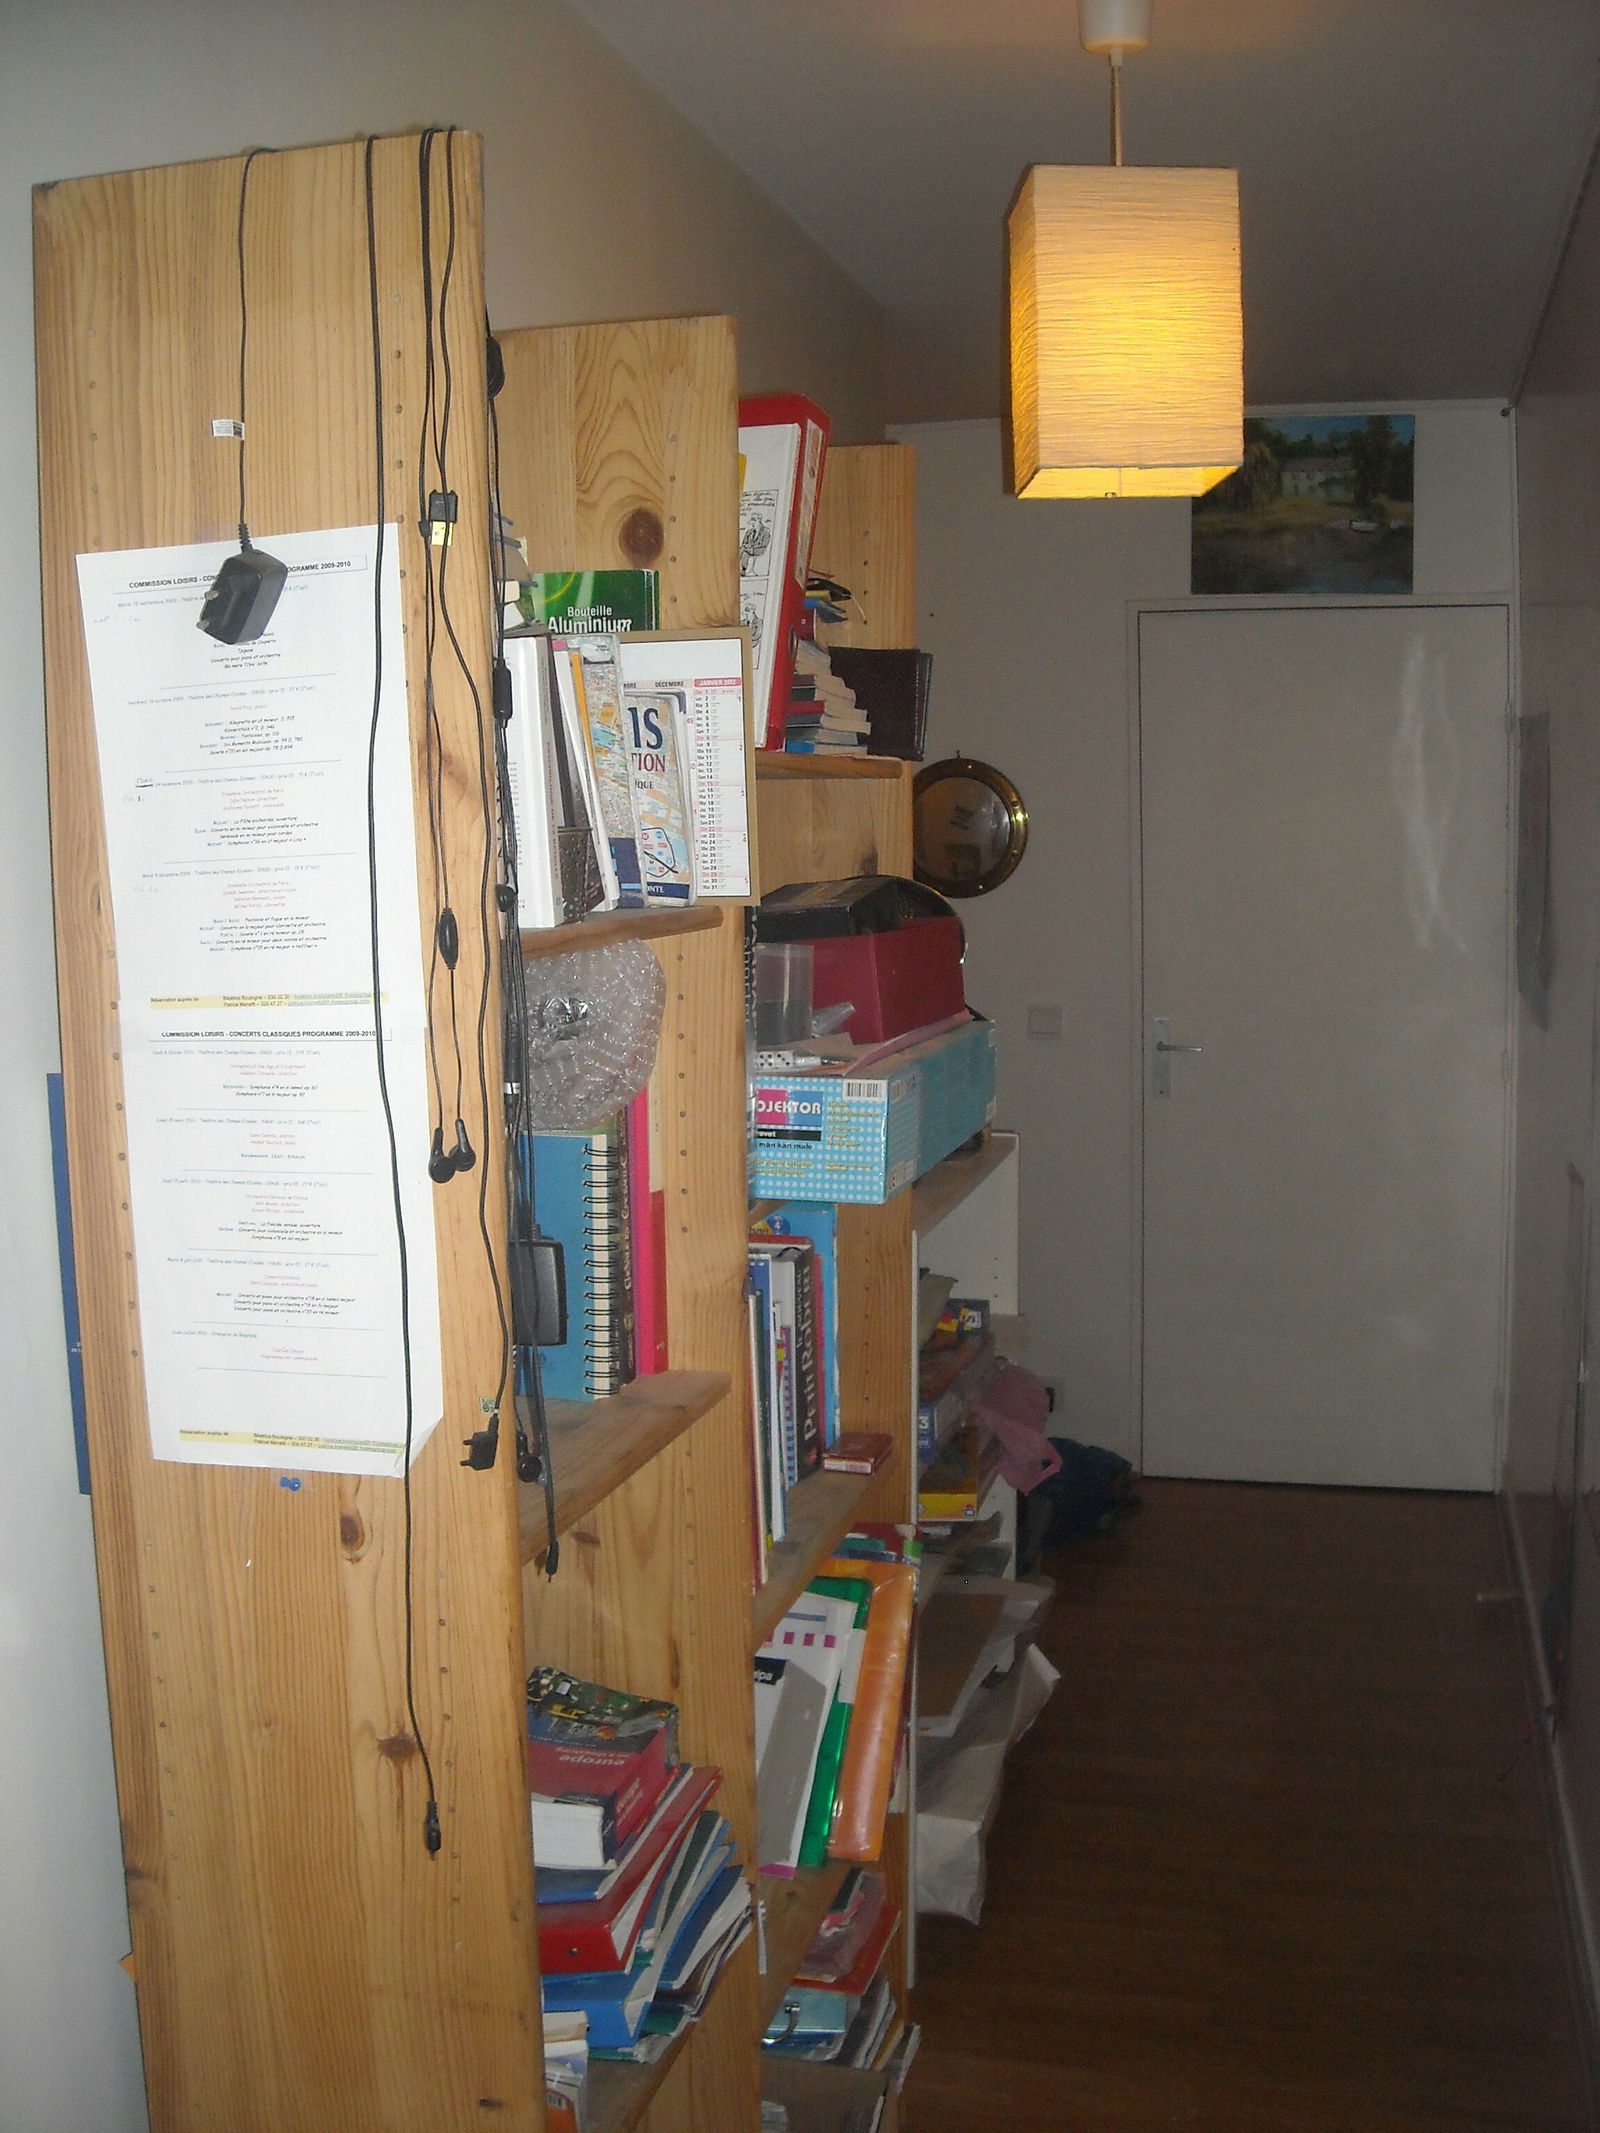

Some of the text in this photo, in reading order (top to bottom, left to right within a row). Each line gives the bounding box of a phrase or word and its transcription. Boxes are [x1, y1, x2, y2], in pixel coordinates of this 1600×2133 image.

[286, 560, 352, 573] OGRAMME 2009-2010
[128, 578, 172, 589] COMMISSION
[173, 576, 198, 586] LOISIRS
[567, 604, 613, 617] Bouteille
[548, 616, 632, 634] Aluminium
[161, 1030, 376, 1038] COMMISSION LOISIRS CONCERTS CLASSIQUES PROGRAMME 2009-2010
